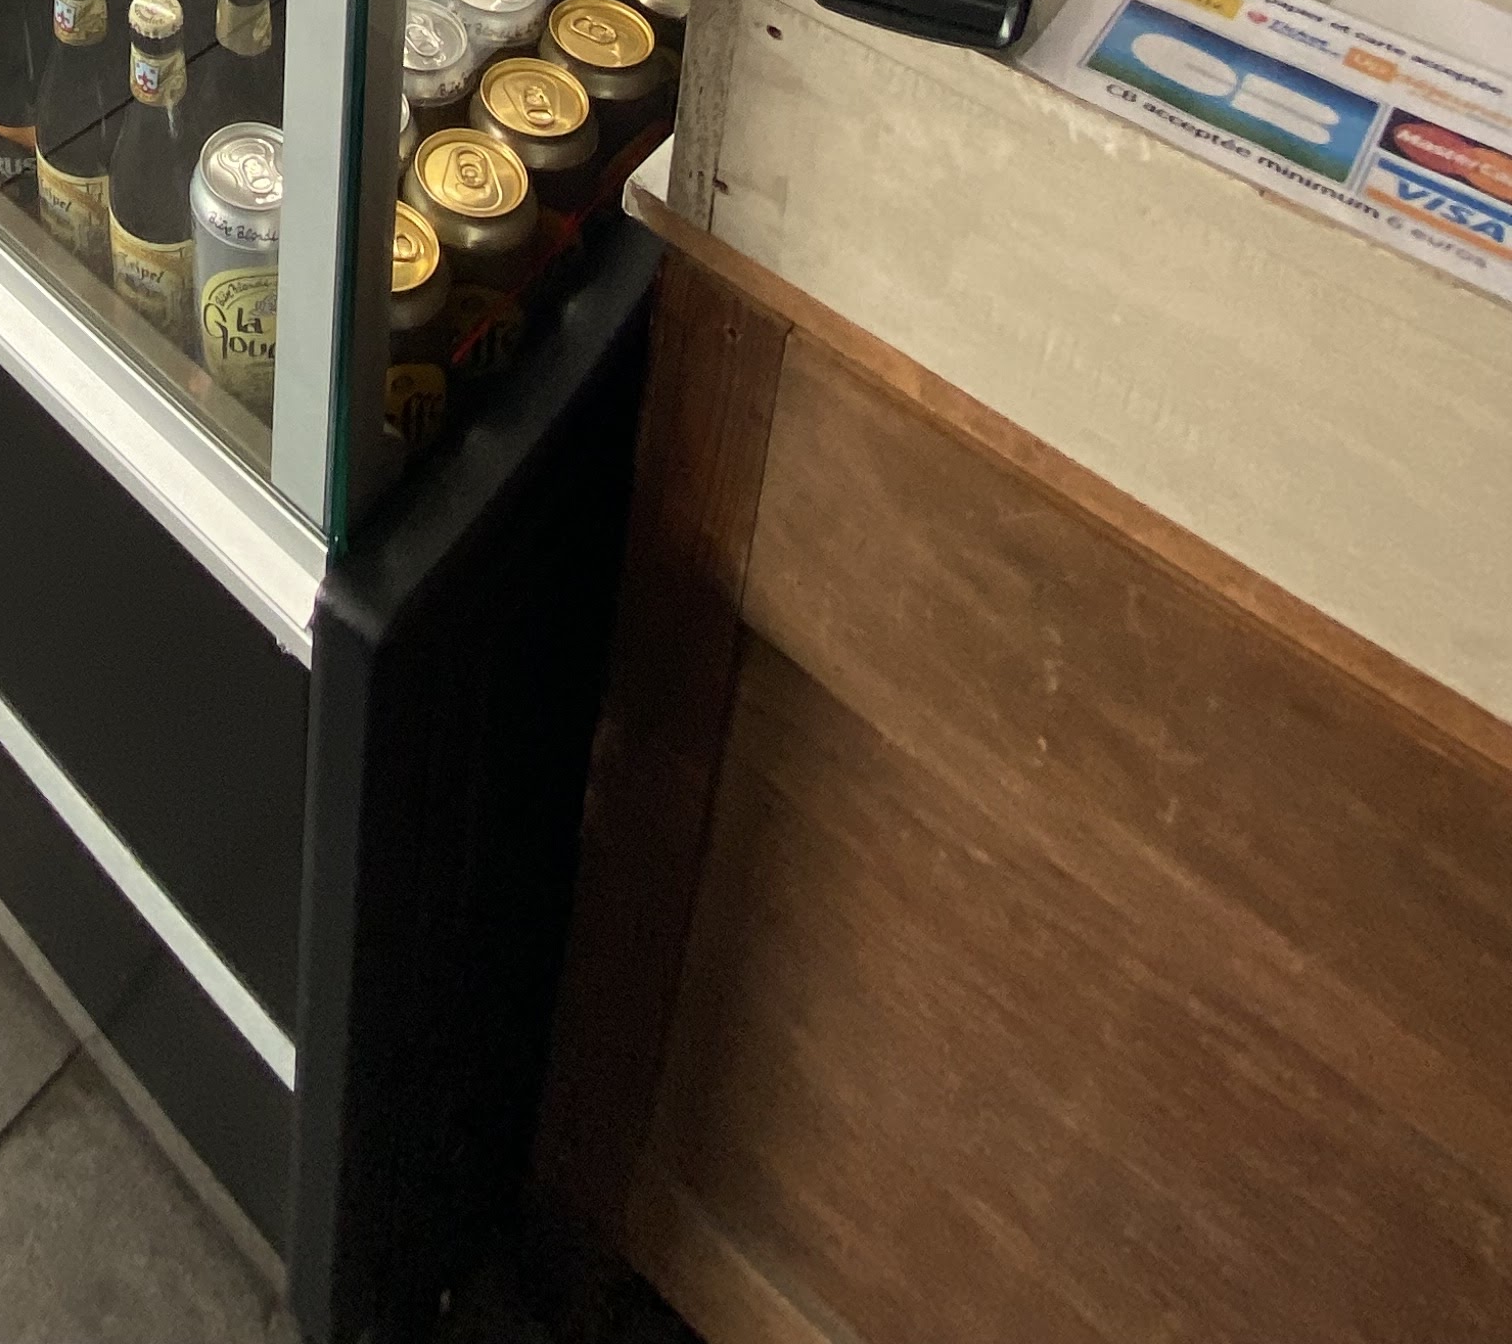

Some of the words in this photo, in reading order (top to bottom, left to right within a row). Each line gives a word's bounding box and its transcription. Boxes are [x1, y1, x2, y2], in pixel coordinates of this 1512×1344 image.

[1105, 82, 1138, 104] CB
[1257, 154, 1381, 220] minimum
[1397, 177, 1506, 244] VISA
